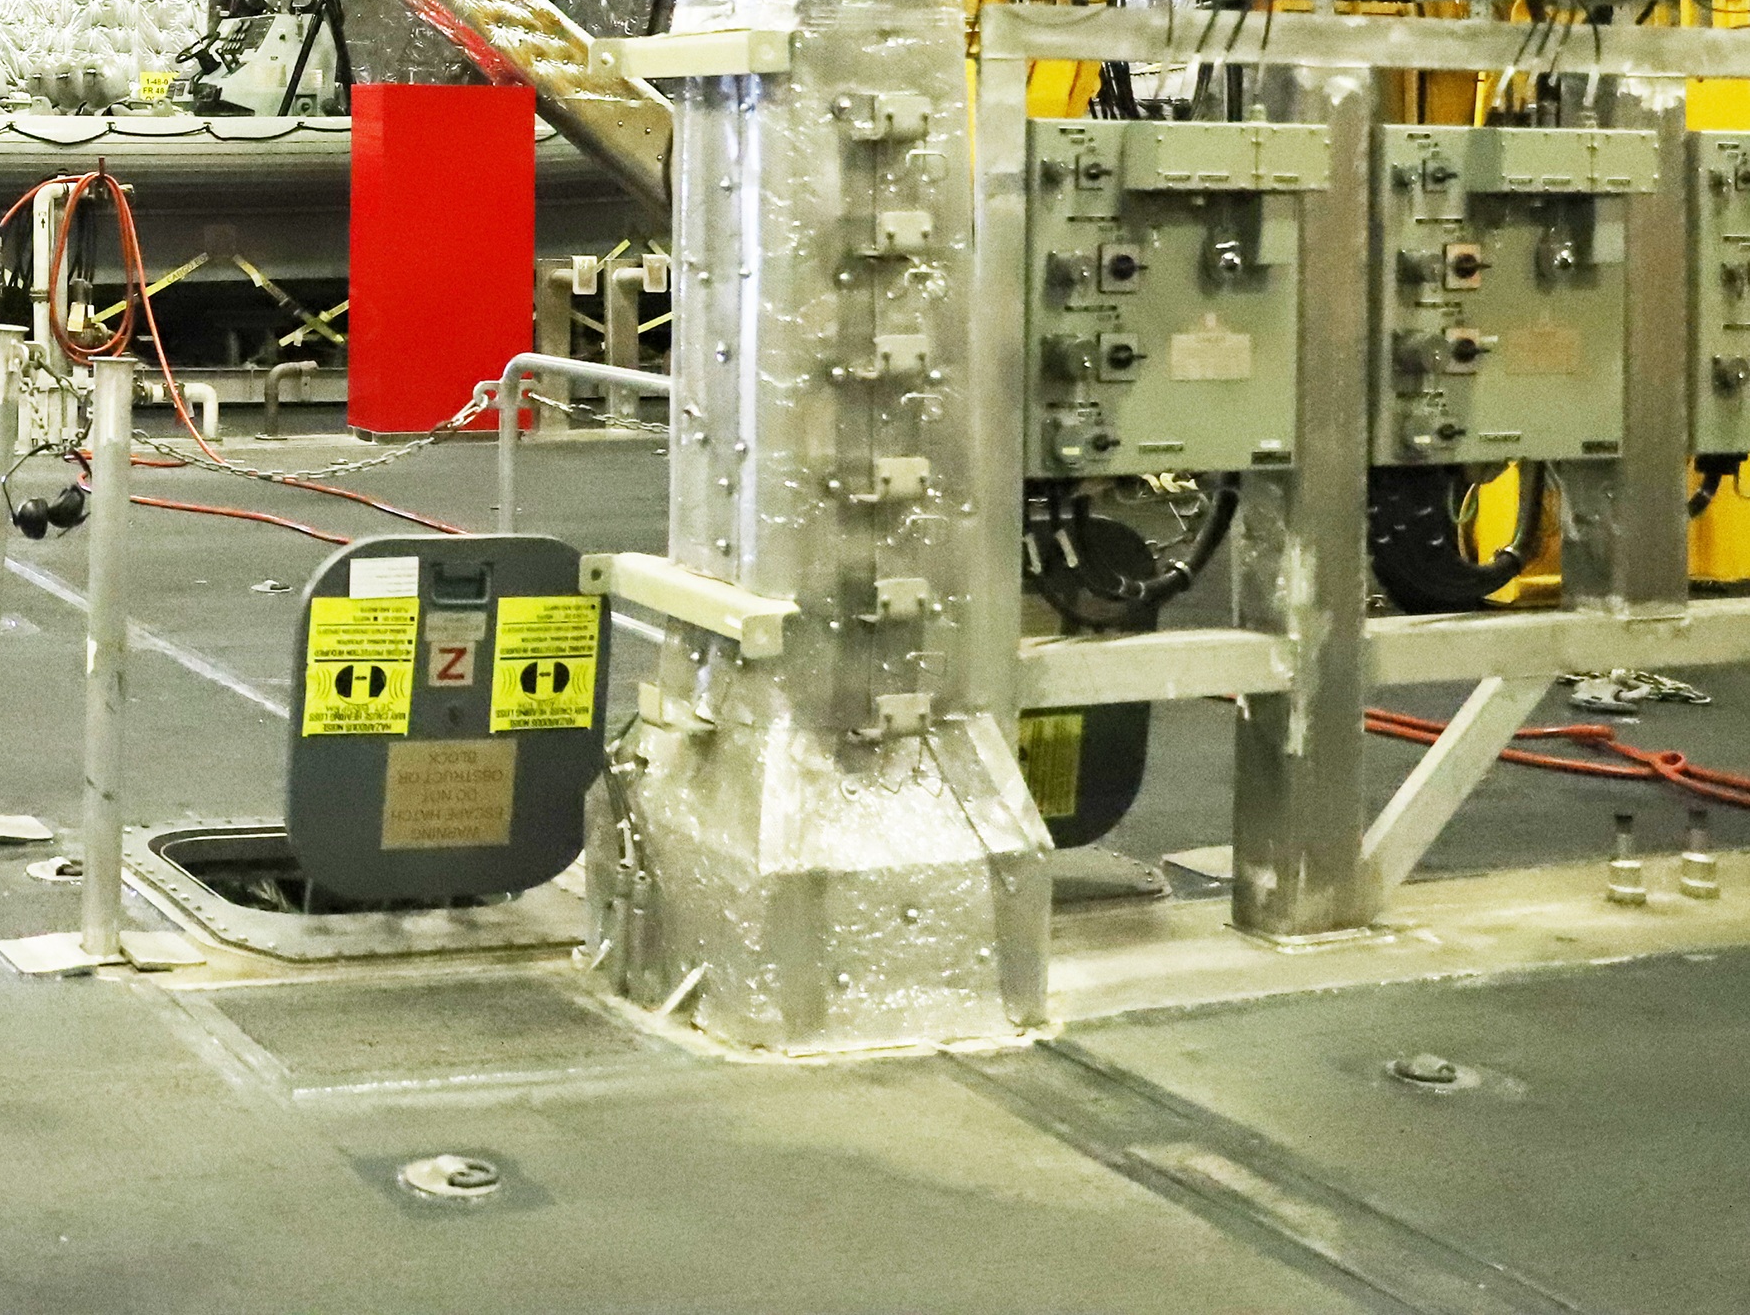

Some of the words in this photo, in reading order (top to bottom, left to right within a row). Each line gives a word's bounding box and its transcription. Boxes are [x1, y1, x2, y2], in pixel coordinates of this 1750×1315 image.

[436, 647, 467, 680] Z
[330, 713, 362, 721] HEARING
[345, 723, 391, 731] HAZARDOUS
[428, 751, 478, 765] BLOCK
[424, 769, 503, 783] OBSTRUCT
[411, 827, 480, 840] WARNING
